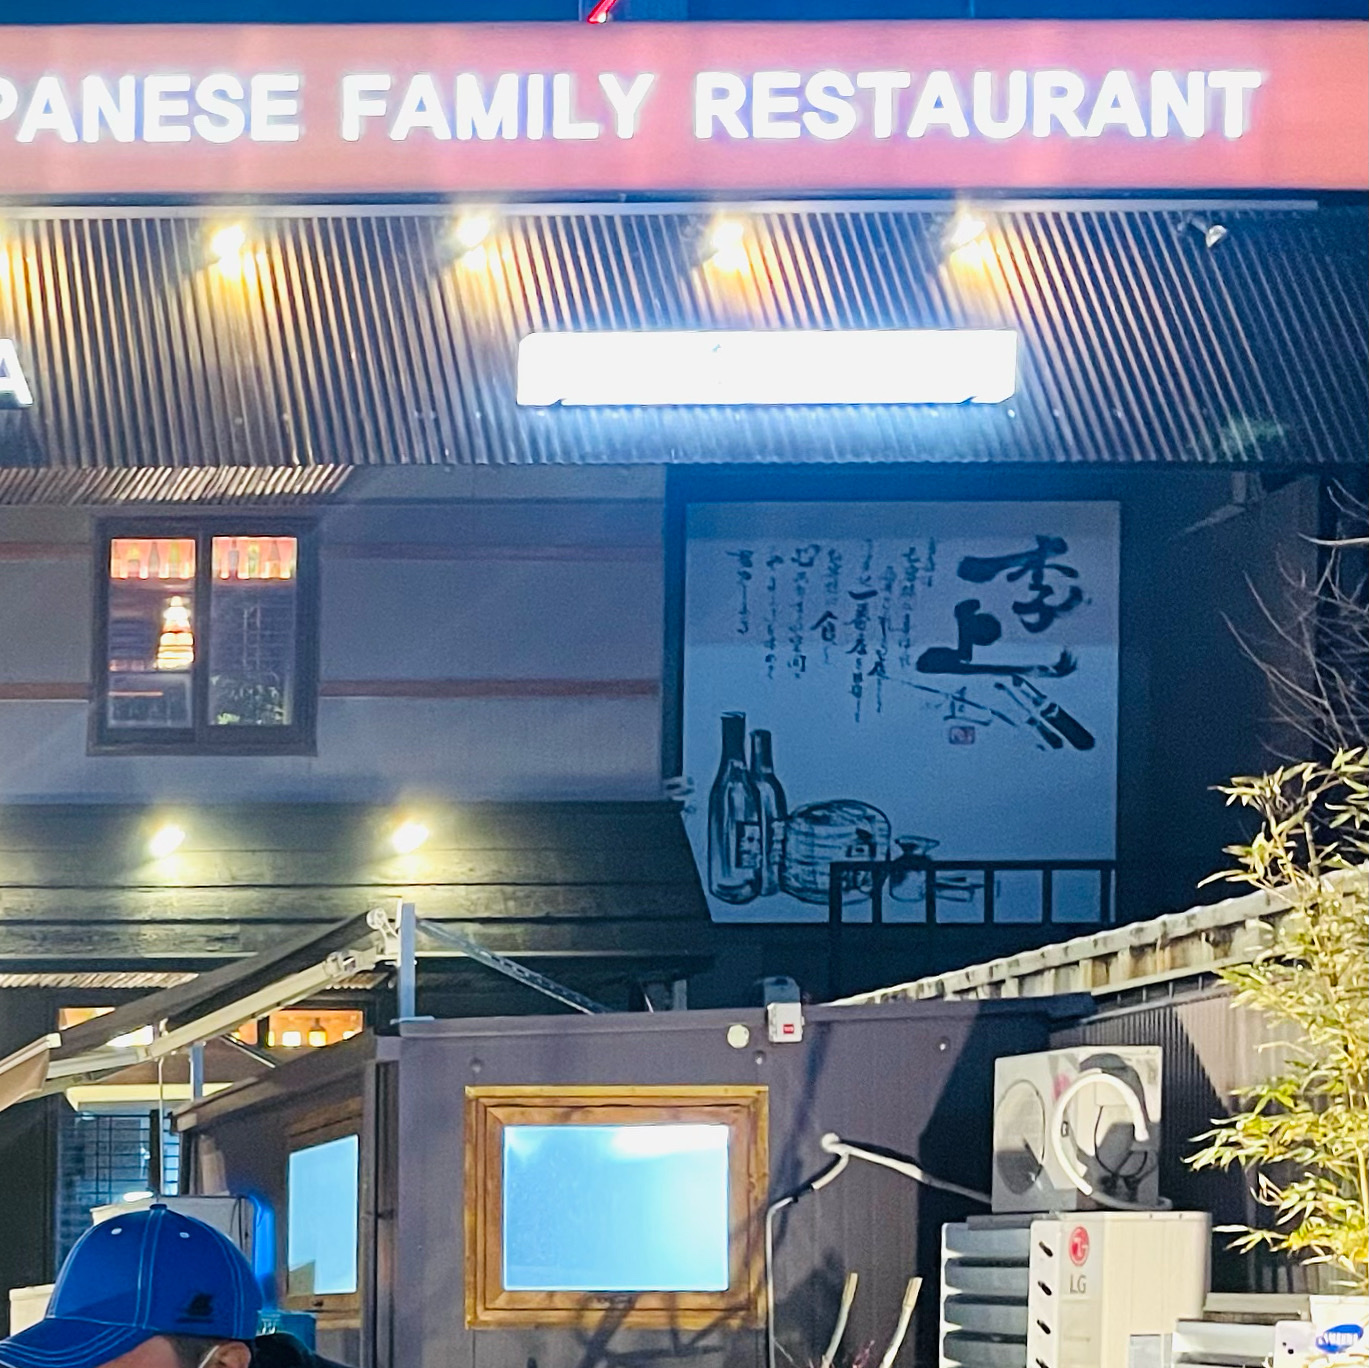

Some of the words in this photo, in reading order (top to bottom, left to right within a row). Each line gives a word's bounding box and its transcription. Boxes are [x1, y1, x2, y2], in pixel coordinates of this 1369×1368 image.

[342, 72, 655, 142] FAMILY
[694, 69, 1263, 140] RESTAURANT
[1069, 1273, 1087, 1294] LG
